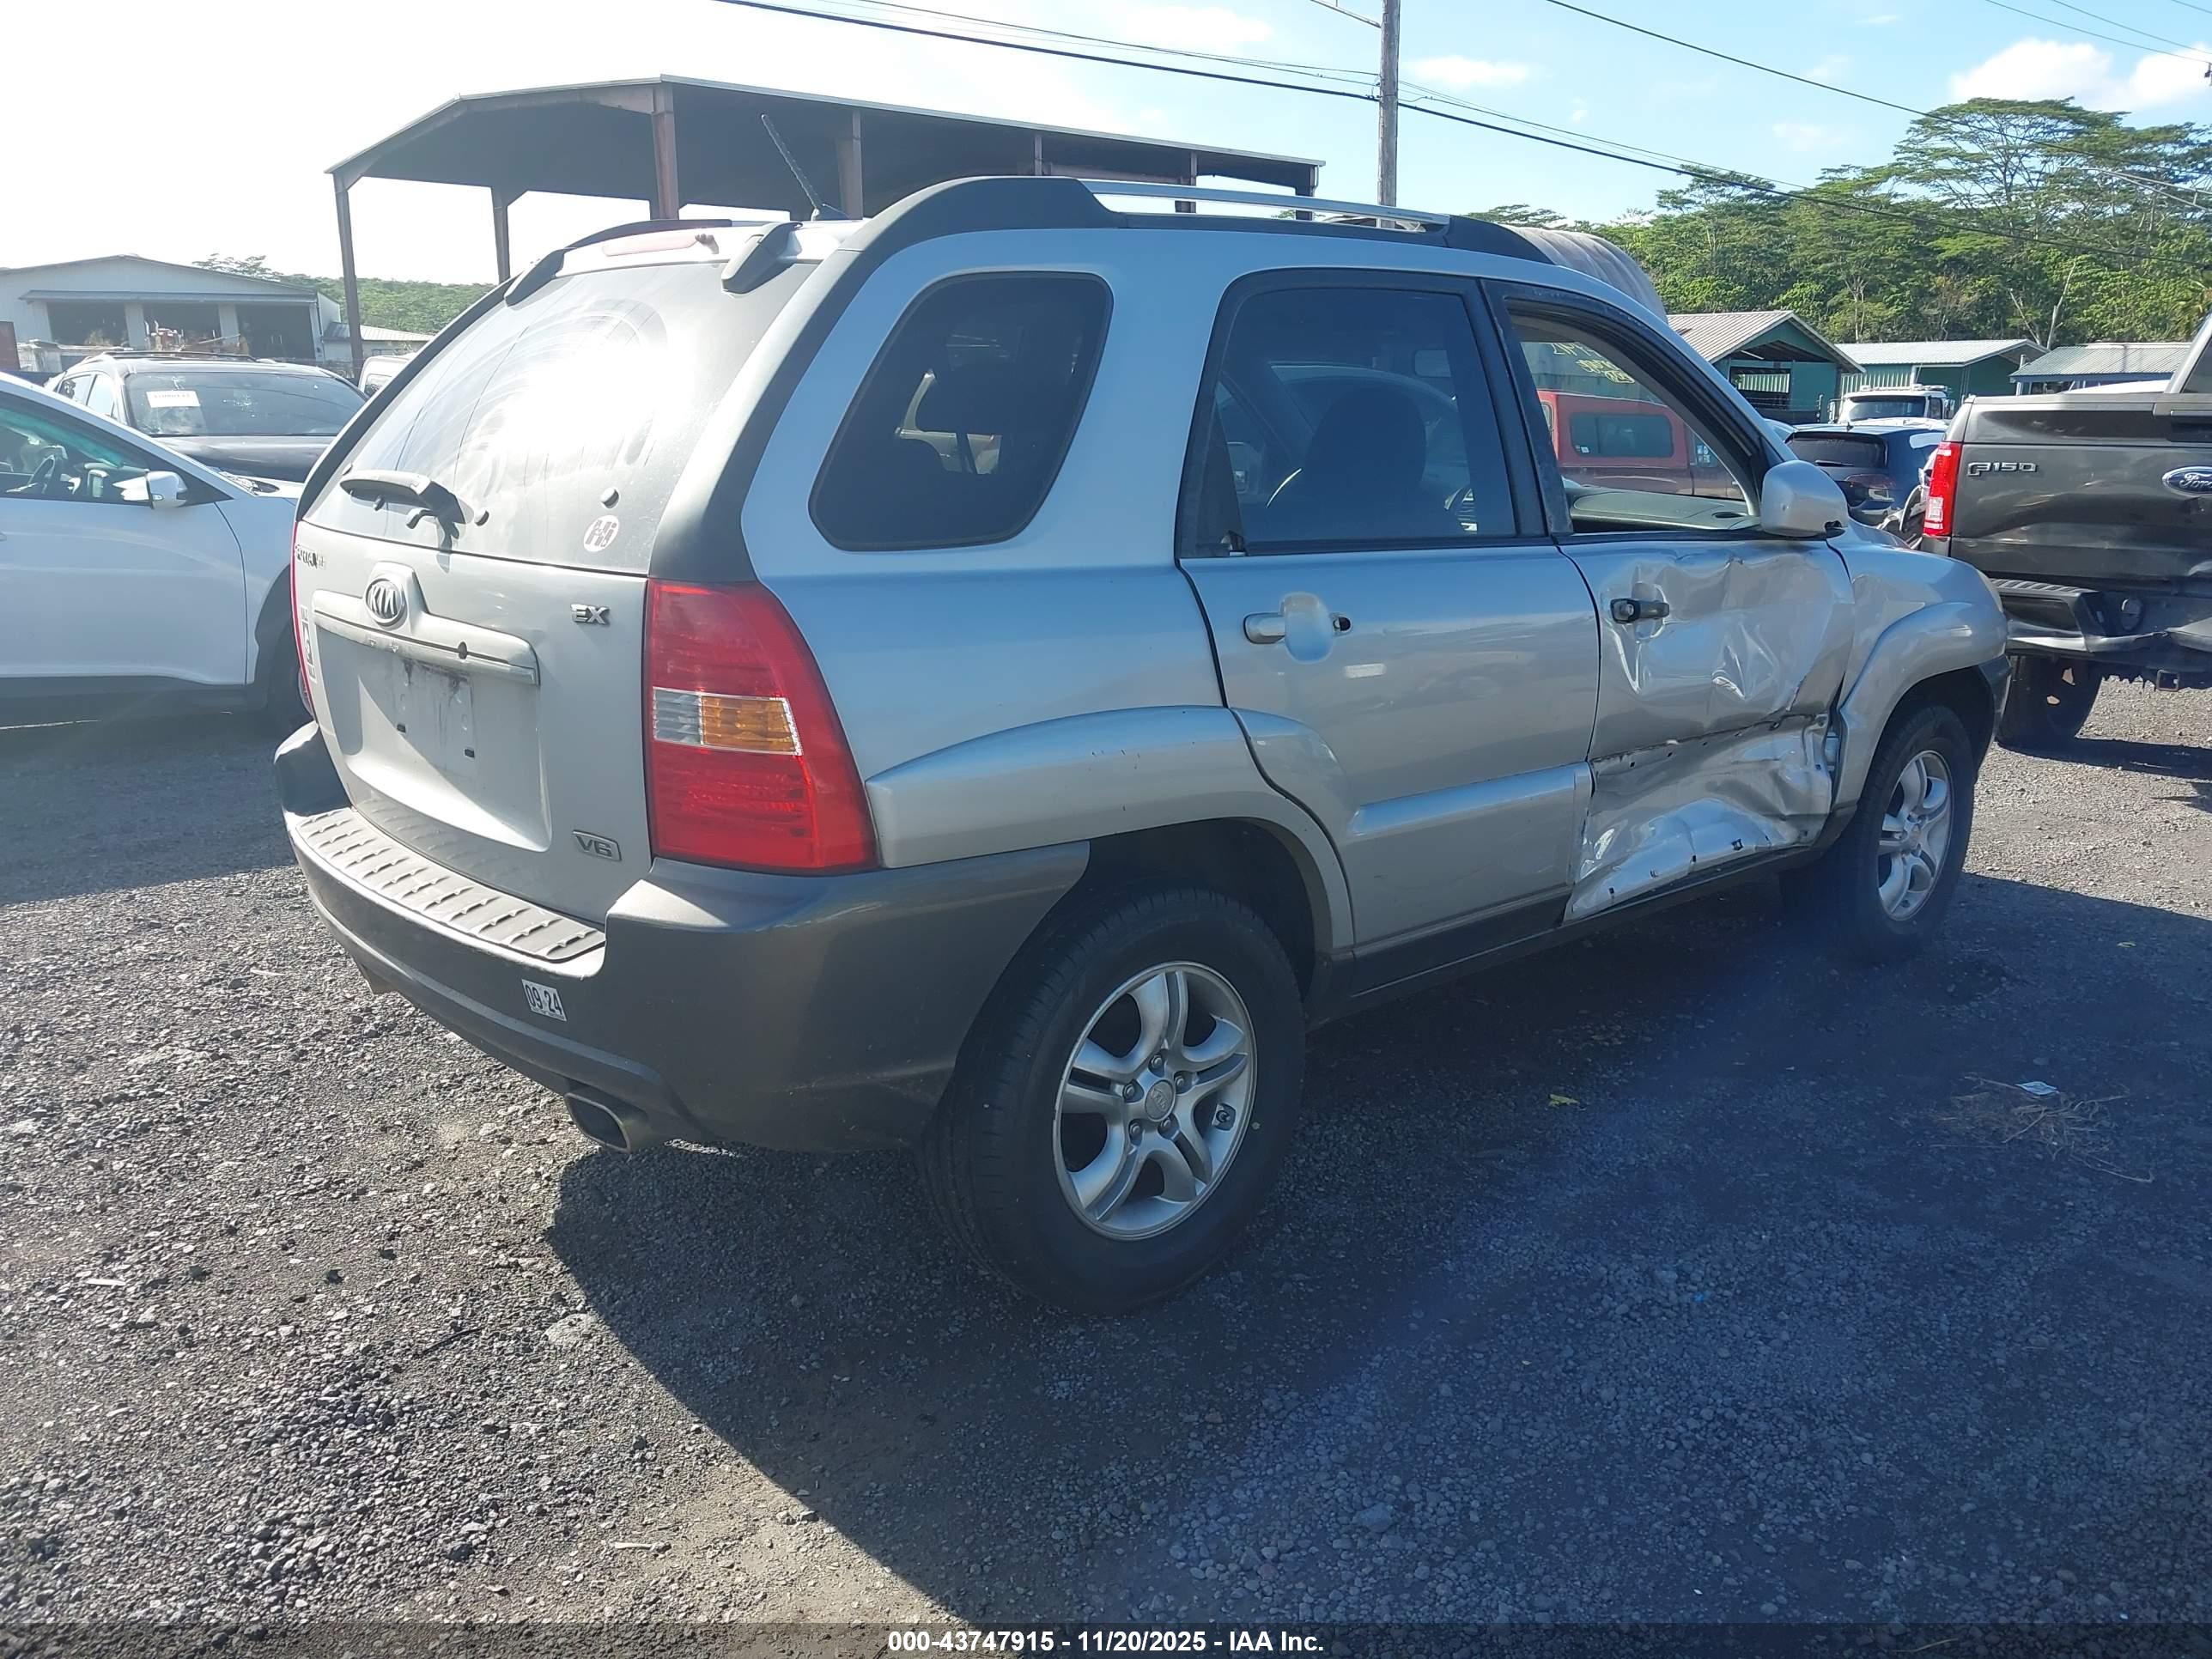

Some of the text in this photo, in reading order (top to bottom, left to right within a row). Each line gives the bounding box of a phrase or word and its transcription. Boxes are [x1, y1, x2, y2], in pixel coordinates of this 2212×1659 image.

[369, 585, 402, 617] KIA
[570, 604, 611, 626] EX
[575, 835, 612, 858] V6
